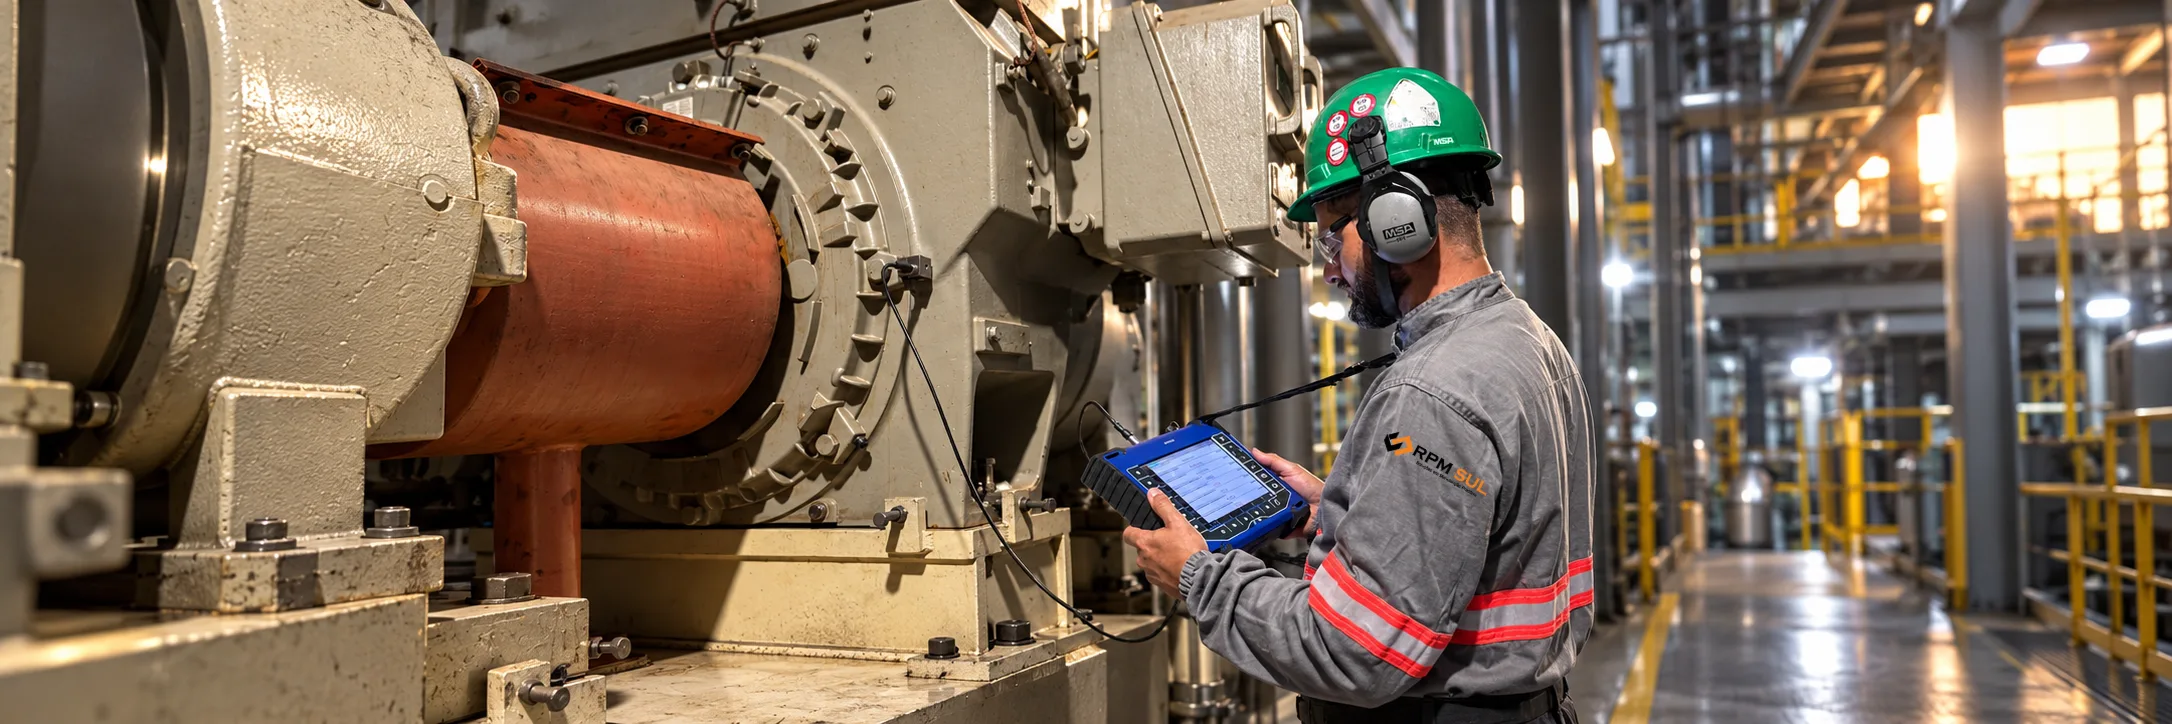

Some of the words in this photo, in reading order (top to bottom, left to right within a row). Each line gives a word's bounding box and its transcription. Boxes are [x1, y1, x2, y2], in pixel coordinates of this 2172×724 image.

[1433, 136, 1454, 146] MSA
[1385, 224, 1414, 239] MSA
[1412, 445, 1453, 475] RPM
[1453, 467, 1488, 497] SUL
